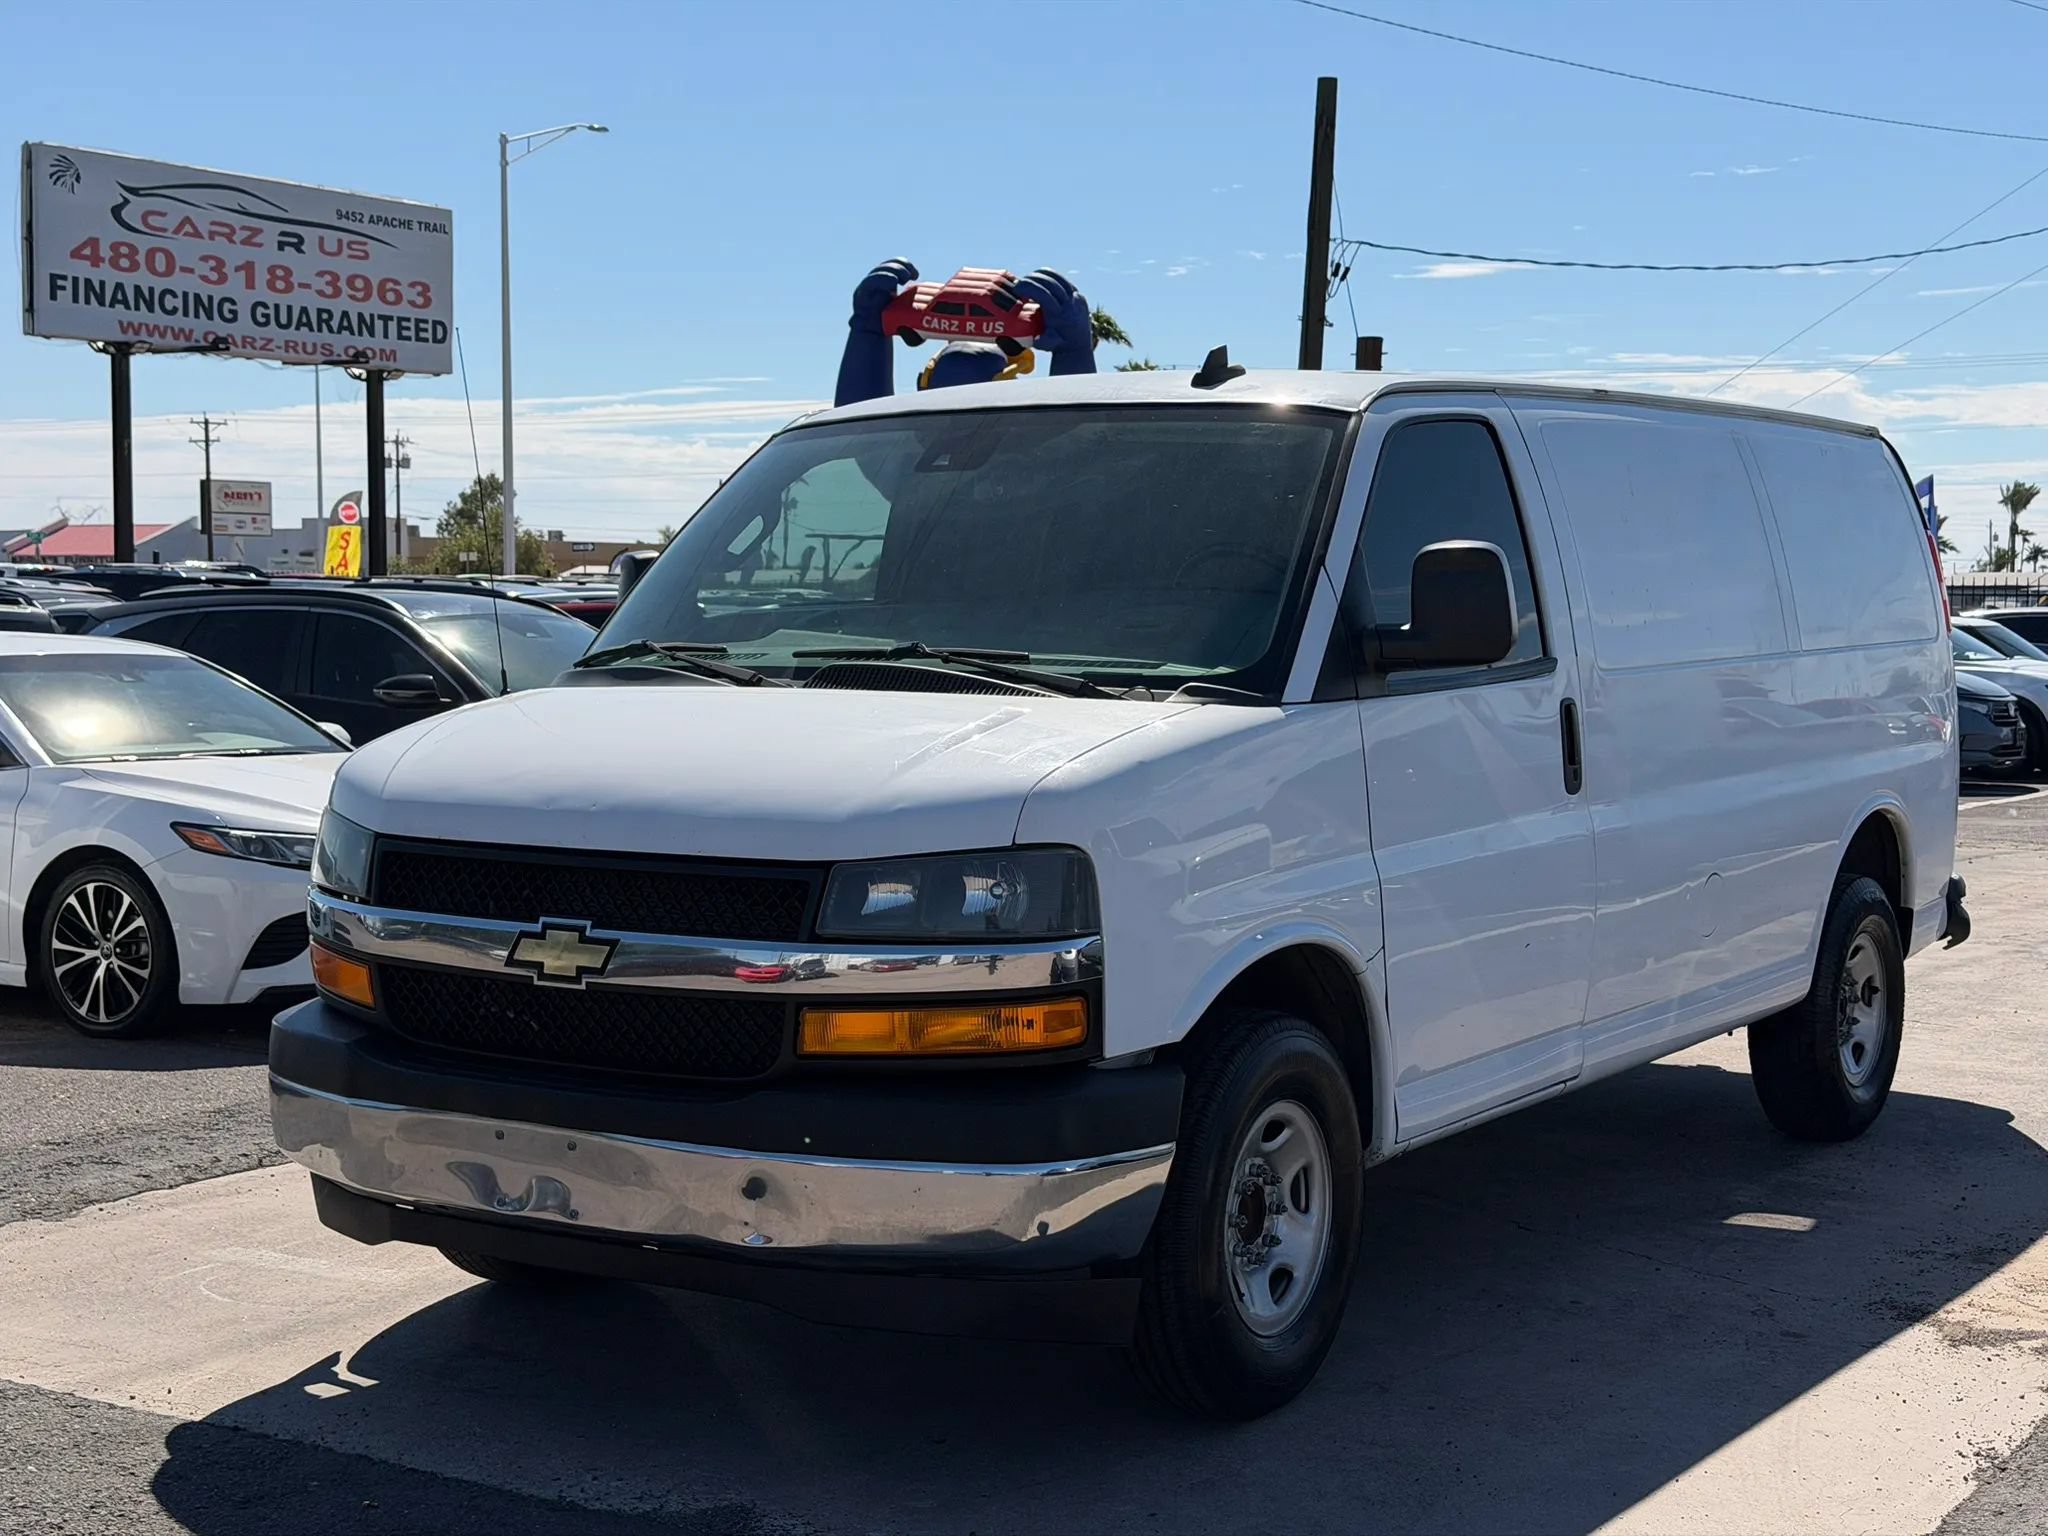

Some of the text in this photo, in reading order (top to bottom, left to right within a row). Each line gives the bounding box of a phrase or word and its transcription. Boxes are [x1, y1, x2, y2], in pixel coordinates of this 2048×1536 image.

[141, 209, 370, 261] CARZ R US
[336, 207, 449, 235] 9452 APACHE TRAIL
[69, 236, 433, 310] 480-318-3963
[49, 272, 448, 345] FINANCING GUARANTEED
[922, 315, 1005, 335] CARZ R US
